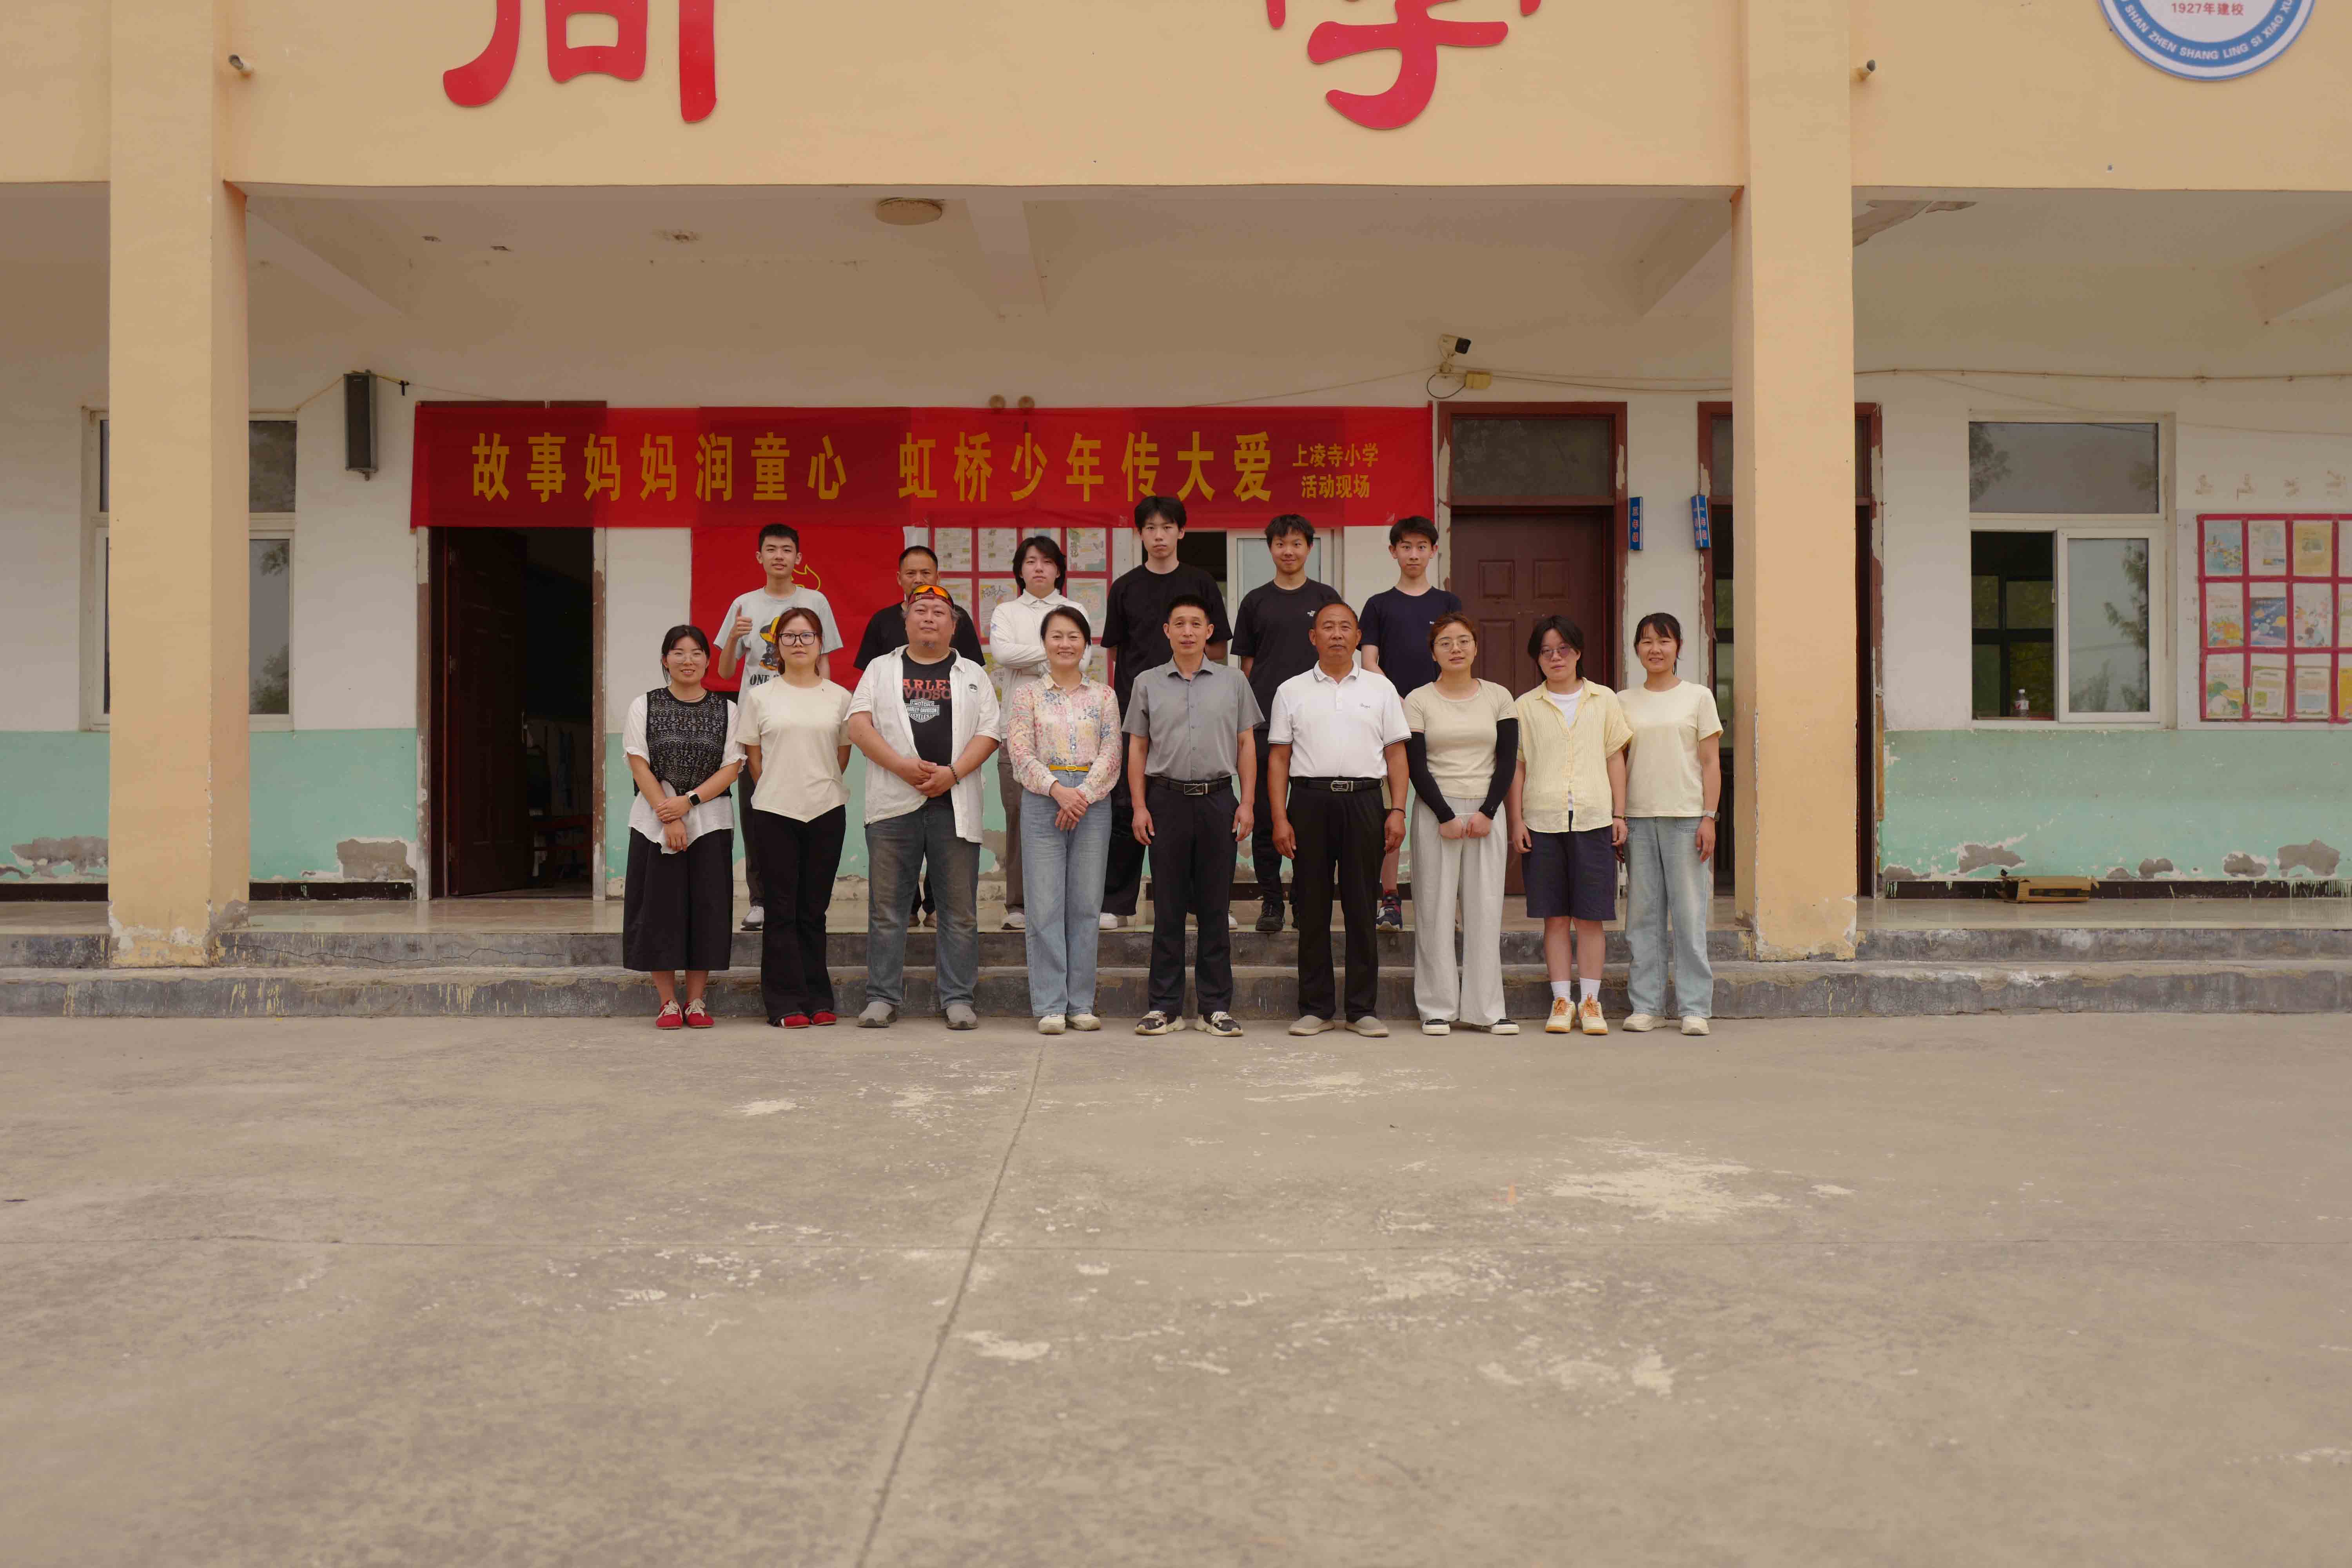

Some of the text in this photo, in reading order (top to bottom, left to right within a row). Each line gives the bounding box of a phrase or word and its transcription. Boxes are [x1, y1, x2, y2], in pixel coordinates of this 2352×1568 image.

[2171, 3, 2245, 16] 1927年建校
[2124, 0, 2295, 60] SHAN ZHEN SHANG LING SI XIAO XU
[472, 432, 1272, 503] 故事妈妈润童心 虹桥少年传大爱
[1292, 443, 1378, 468] 上凌寺小学
[1301, 474, 1370, 499] 活动现场
[903, 679, 951, 690] ARLE
